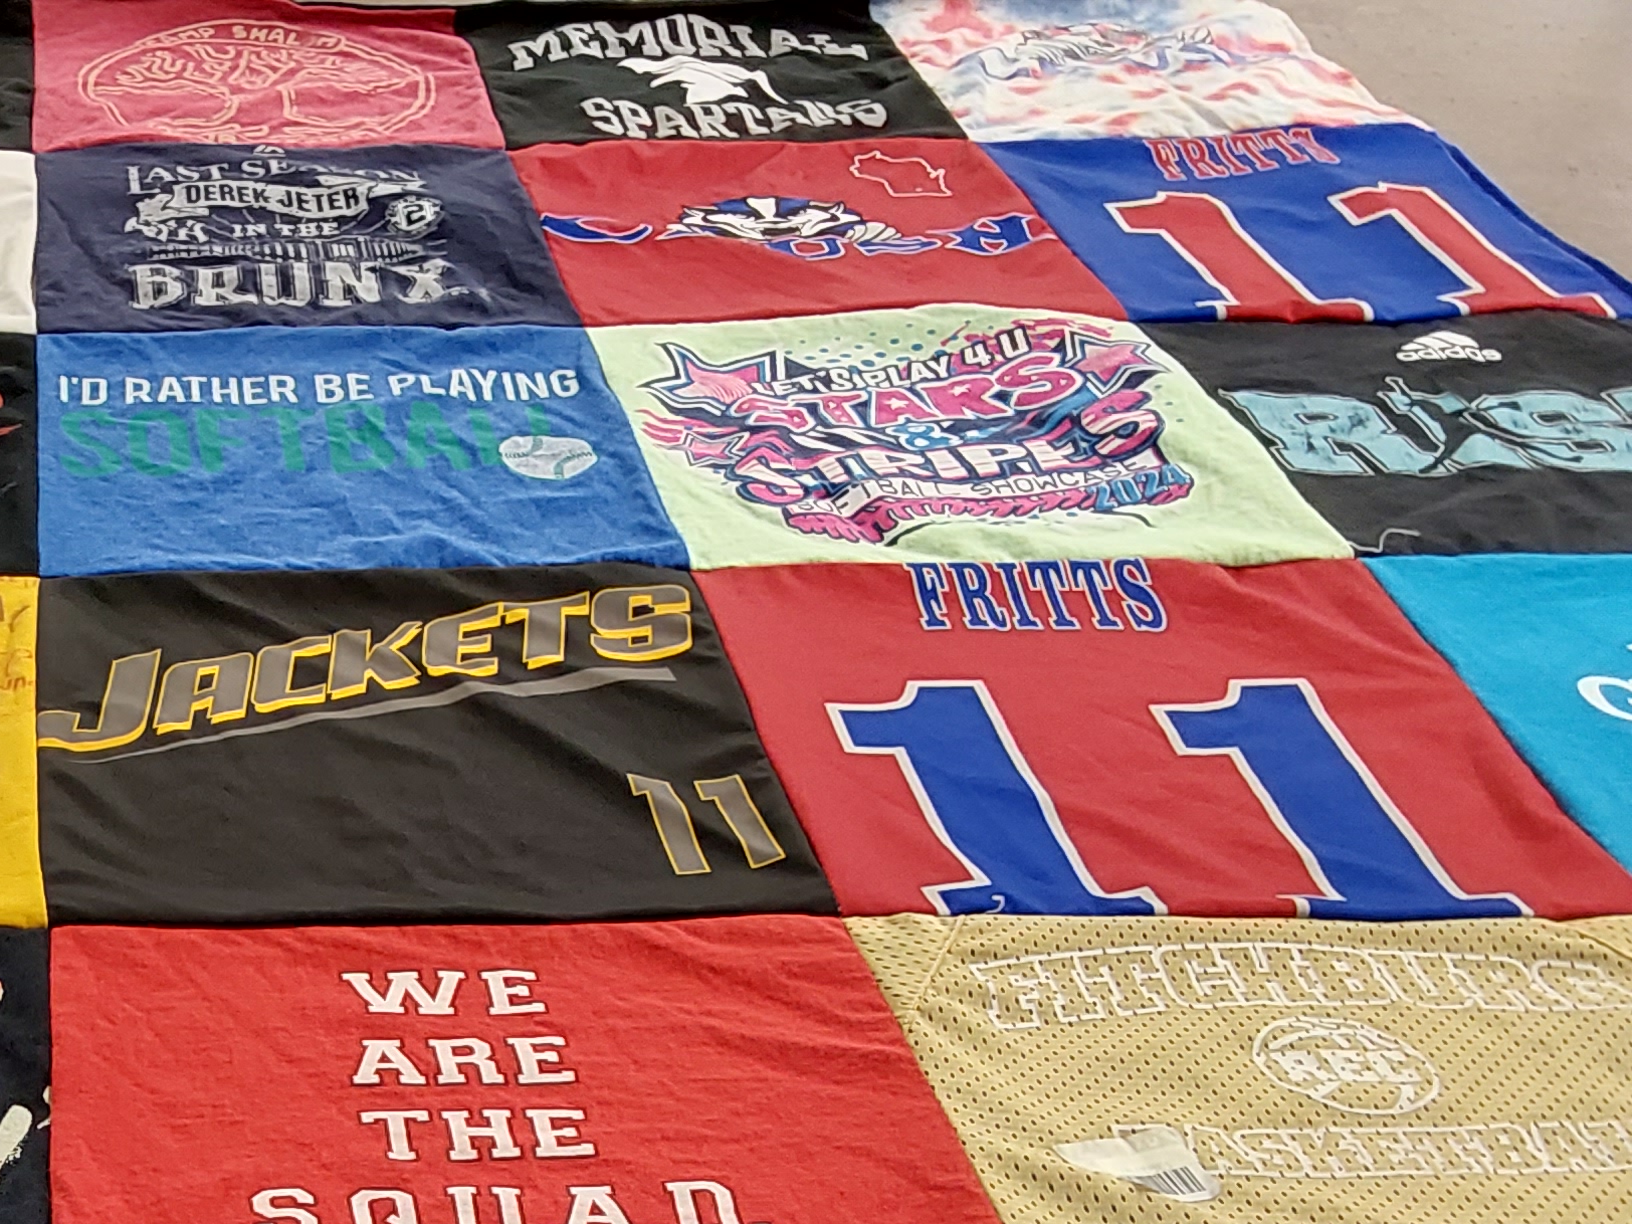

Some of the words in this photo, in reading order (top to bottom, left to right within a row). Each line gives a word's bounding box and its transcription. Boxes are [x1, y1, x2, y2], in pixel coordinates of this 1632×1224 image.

[507, 14, 868, 71] MEMORIAL
[580, 97, 888, 139] SPARTANS
[126, 162, 229, 195] LAST
[185, 184, 269, 204] DEREK
[282, 187, 360, 213] JETER
[232, 223, 267, 237] IN
[277, 221, 341, 237] THE
[1104, 181, 1617, 322] 11
[751, 366, 854, 397] LET'S
[864, 354, 955, 389] PLAY
[964, 339, 994, 367] 4
[999, 328, 1030, 358] U
[1396, 344, 1503, 363] adidas
[58, 374, 108, 406] I'D
[125, 375, 299, 405] RATHER
[315, 372, 375, 405] BE
[390, 367, 581, 400] PLAYING
[730, 351, 1085, 433] STARS
[734, 389, 1160, 504] STRIPES
[970, 458, 1152, 496] SHOWCASE
[1090, 463, 1192, 511] 2024
[904, 557, 1169, 631] FRITTS
[37, 584, 695, 752] JACKETS
[626, 772, 786, 875] 11
[824, 679, 1534, 917] 11
[340, 969, 549, 1017] WE
[350, 1035, 579, 1087] ARE
[1270, 1048, 1420, 1084] REC
[359, 1108, 597, 1162] THE
